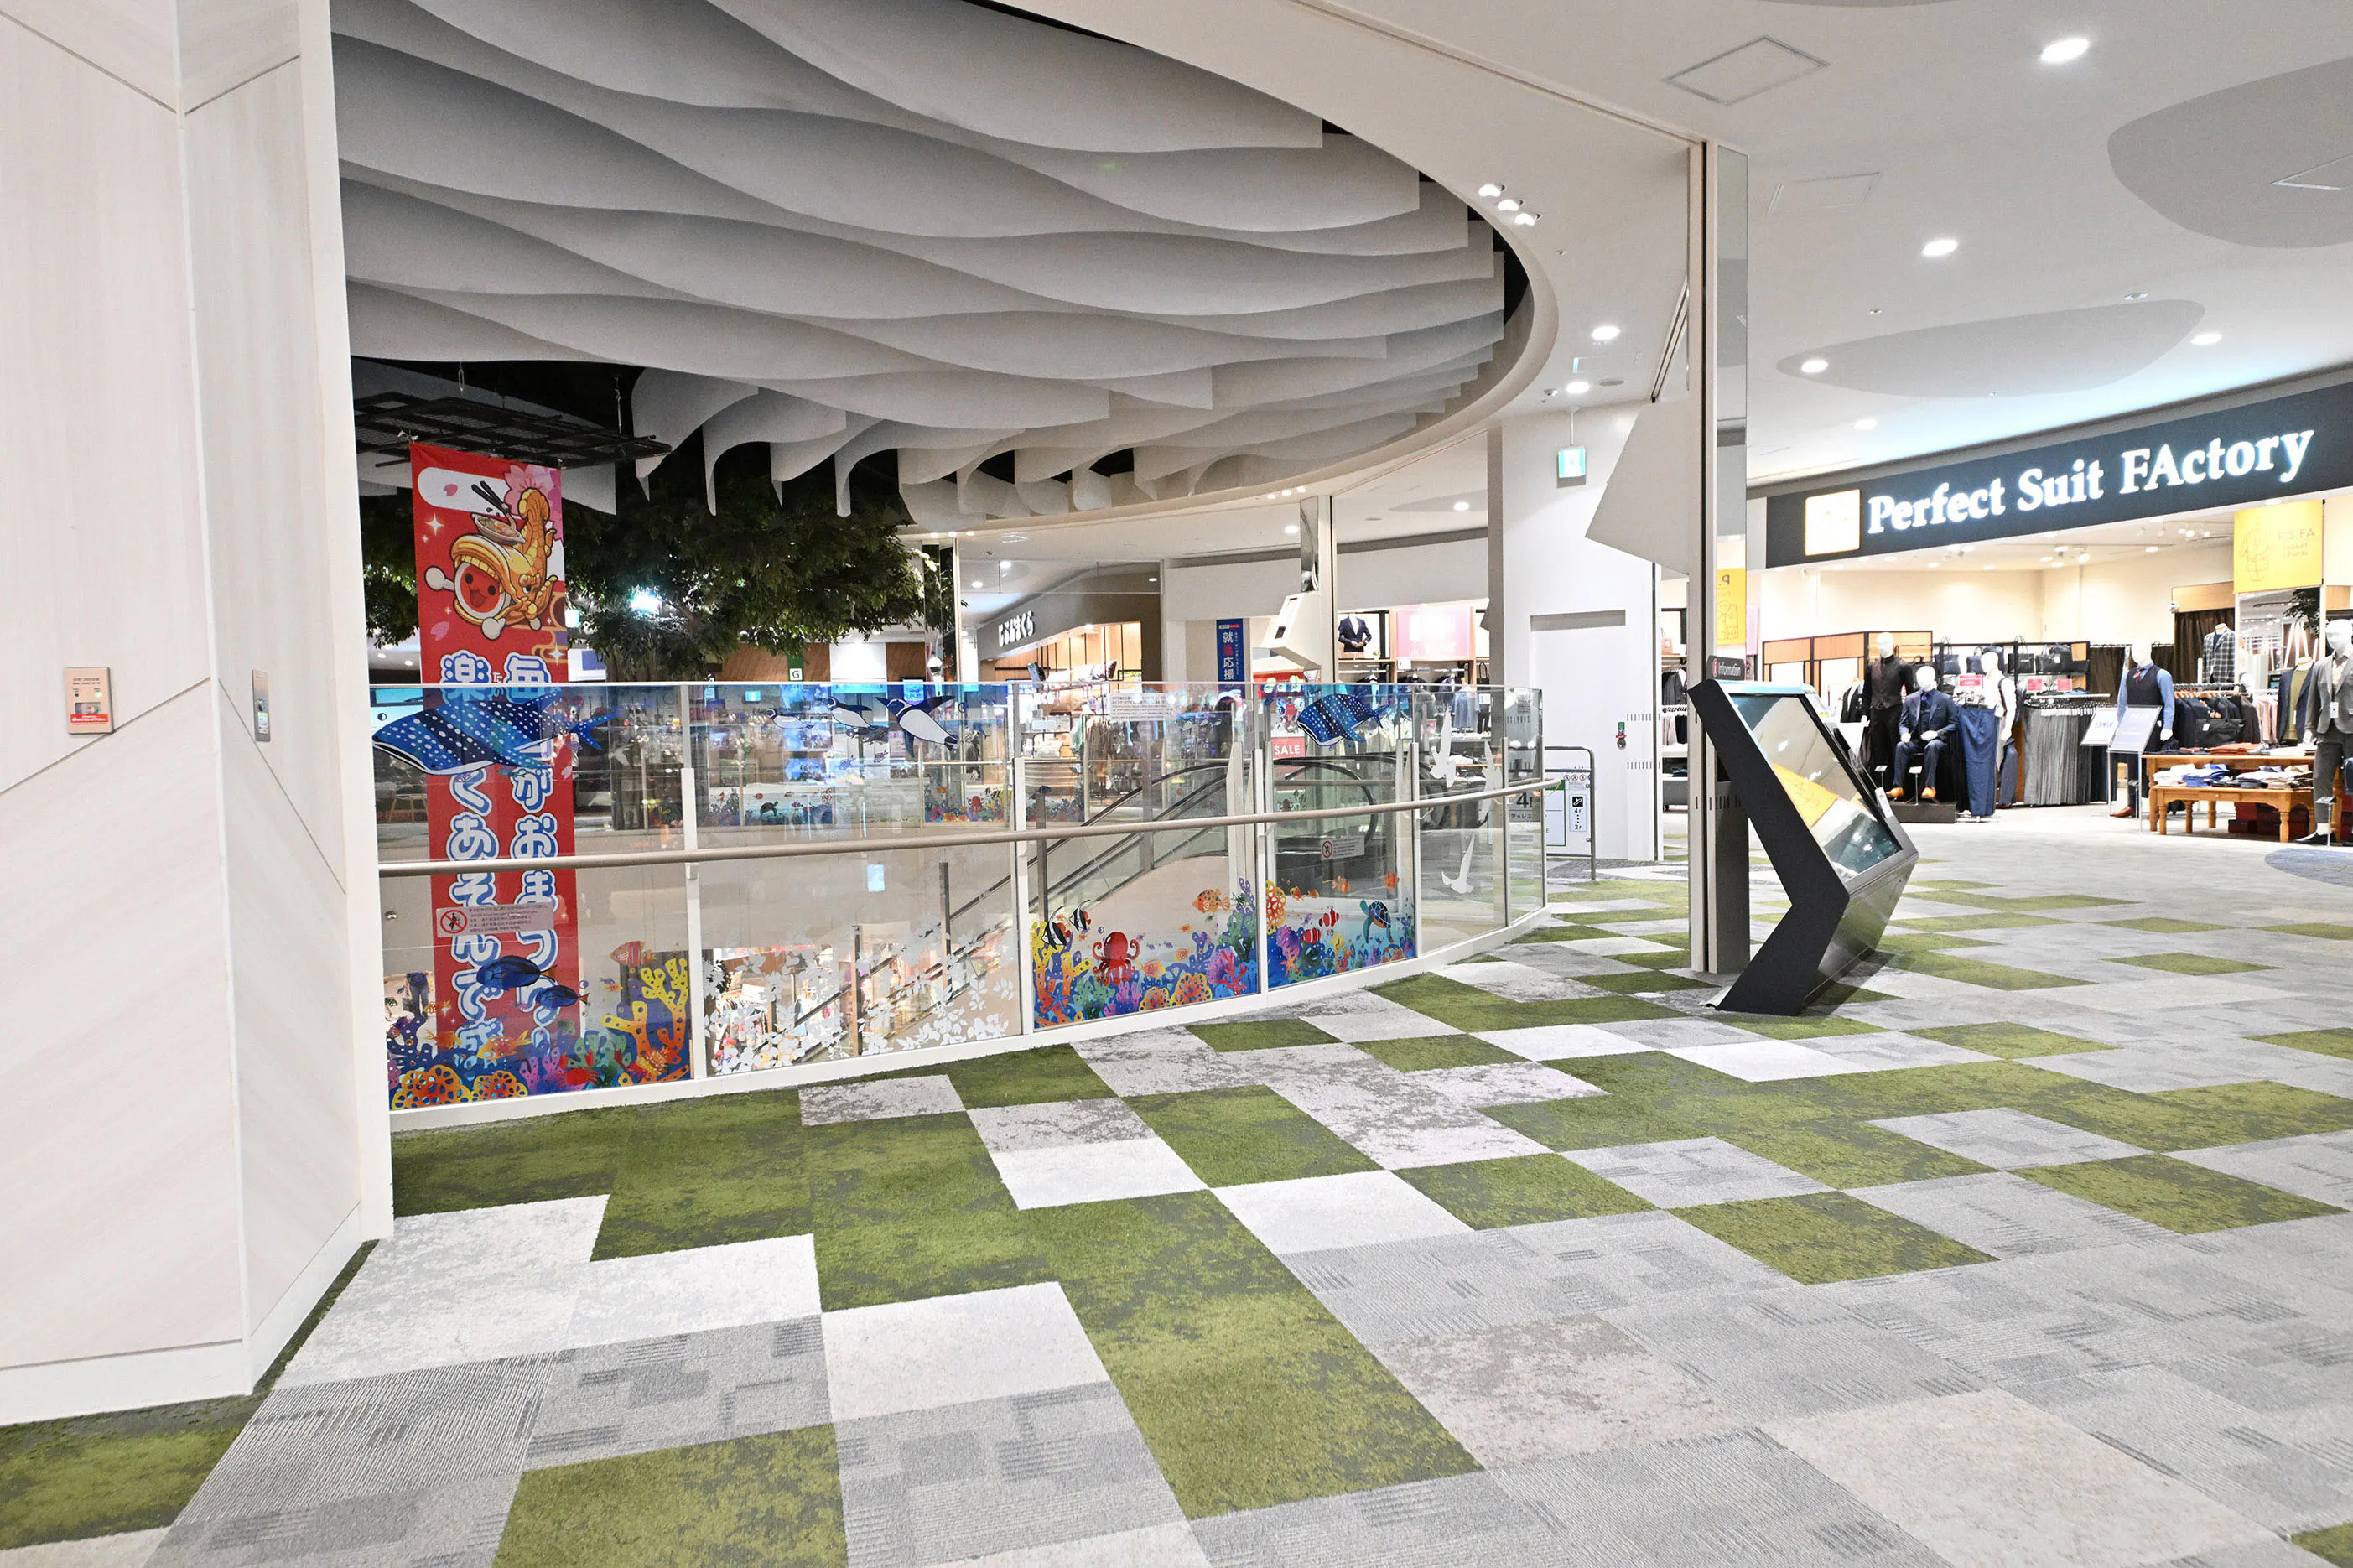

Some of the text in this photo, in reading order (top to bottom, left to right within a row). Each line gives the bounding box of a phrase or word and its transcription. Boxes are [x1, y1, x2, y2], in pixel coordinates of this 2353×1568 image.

[1867, 429, 2314, 534] Perfect Suit FActory
[792, 670, 800, 678] G
[1717, 662, 1741, 677] Information
[1274, 745, 1301, 755] SALE
